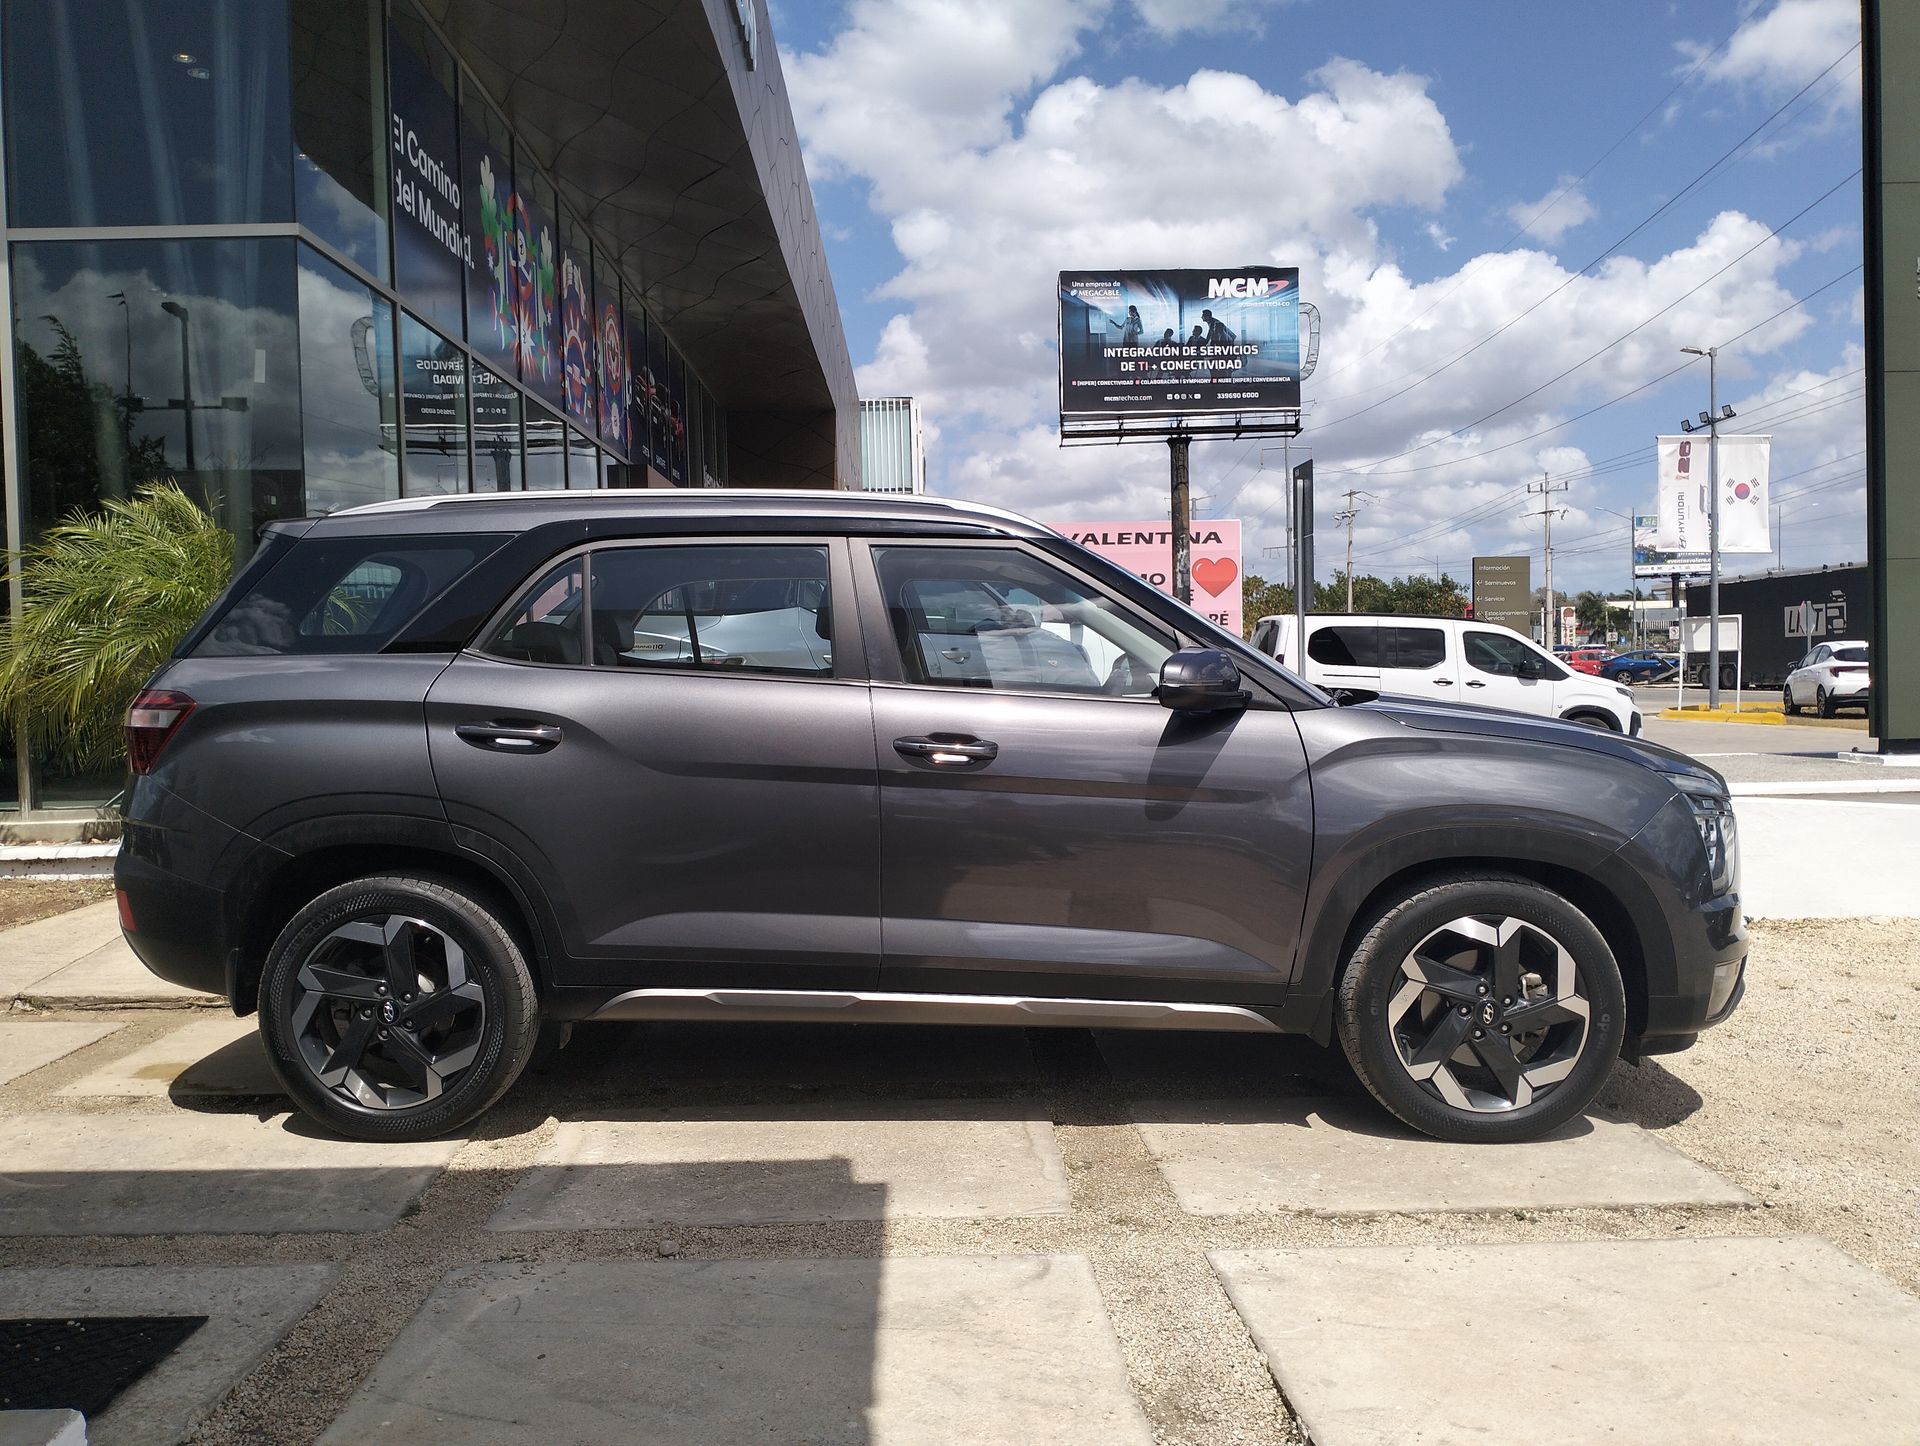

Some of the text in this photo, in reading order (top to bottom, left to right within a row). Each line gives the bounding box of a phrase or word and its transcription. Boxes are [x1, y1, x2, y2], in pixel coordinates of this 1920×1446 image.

[407, 130, 460, 210] Camino
[1208, 278, 1269, 299] MCM
[1103, 345, 1258, 358] INTEGRACIÓN DE SERVICIOS
[1120, 362, 1136, 372] DE
[1138, 361, 1148, 371] TI
[1160, 359, 1242, 371] CONECTIVIDAD
[1064, 531, 1222, 546] VALENTNA
